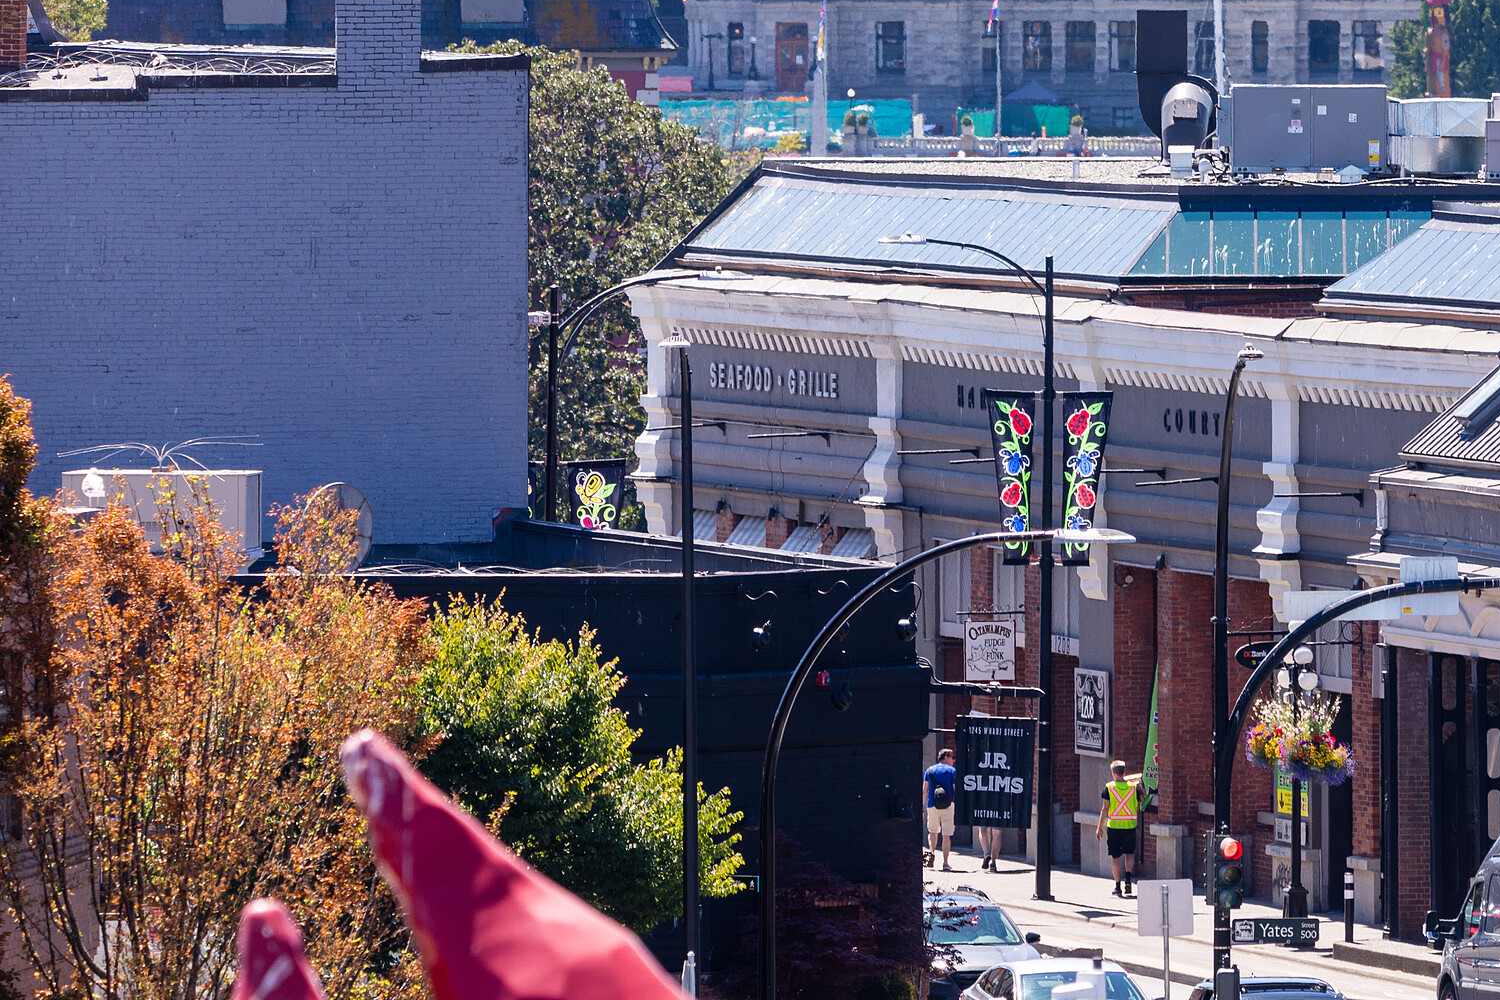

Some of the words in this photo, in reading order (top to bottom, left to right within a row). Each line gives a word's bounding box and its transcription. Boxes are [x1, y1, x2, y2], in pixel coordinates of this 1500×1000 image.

[709, 362, 773, 392] SEAFOOD
[787, 368, 838, 399] GRILLE
[1163, 408, 1220, 437] COURT
[984, 638, 1006, 647] FUDGE
[1055, 636, 1070, 654] 1208
[986, 652, 1005, 660] FUNK
[1080, 695, 1095, 719] 1208
[968, 726, 982, 735] 1245
[983, 727, 1002, 736] WHARF
[1003, 728, 1024, 737] STREET
[978, 751, 1011, 770] J.R.
[963, 775, 1024, 794] SLIMS
[1260, 923, 1294, 937] Yates
[1300, 930, 1317, 939] 500
